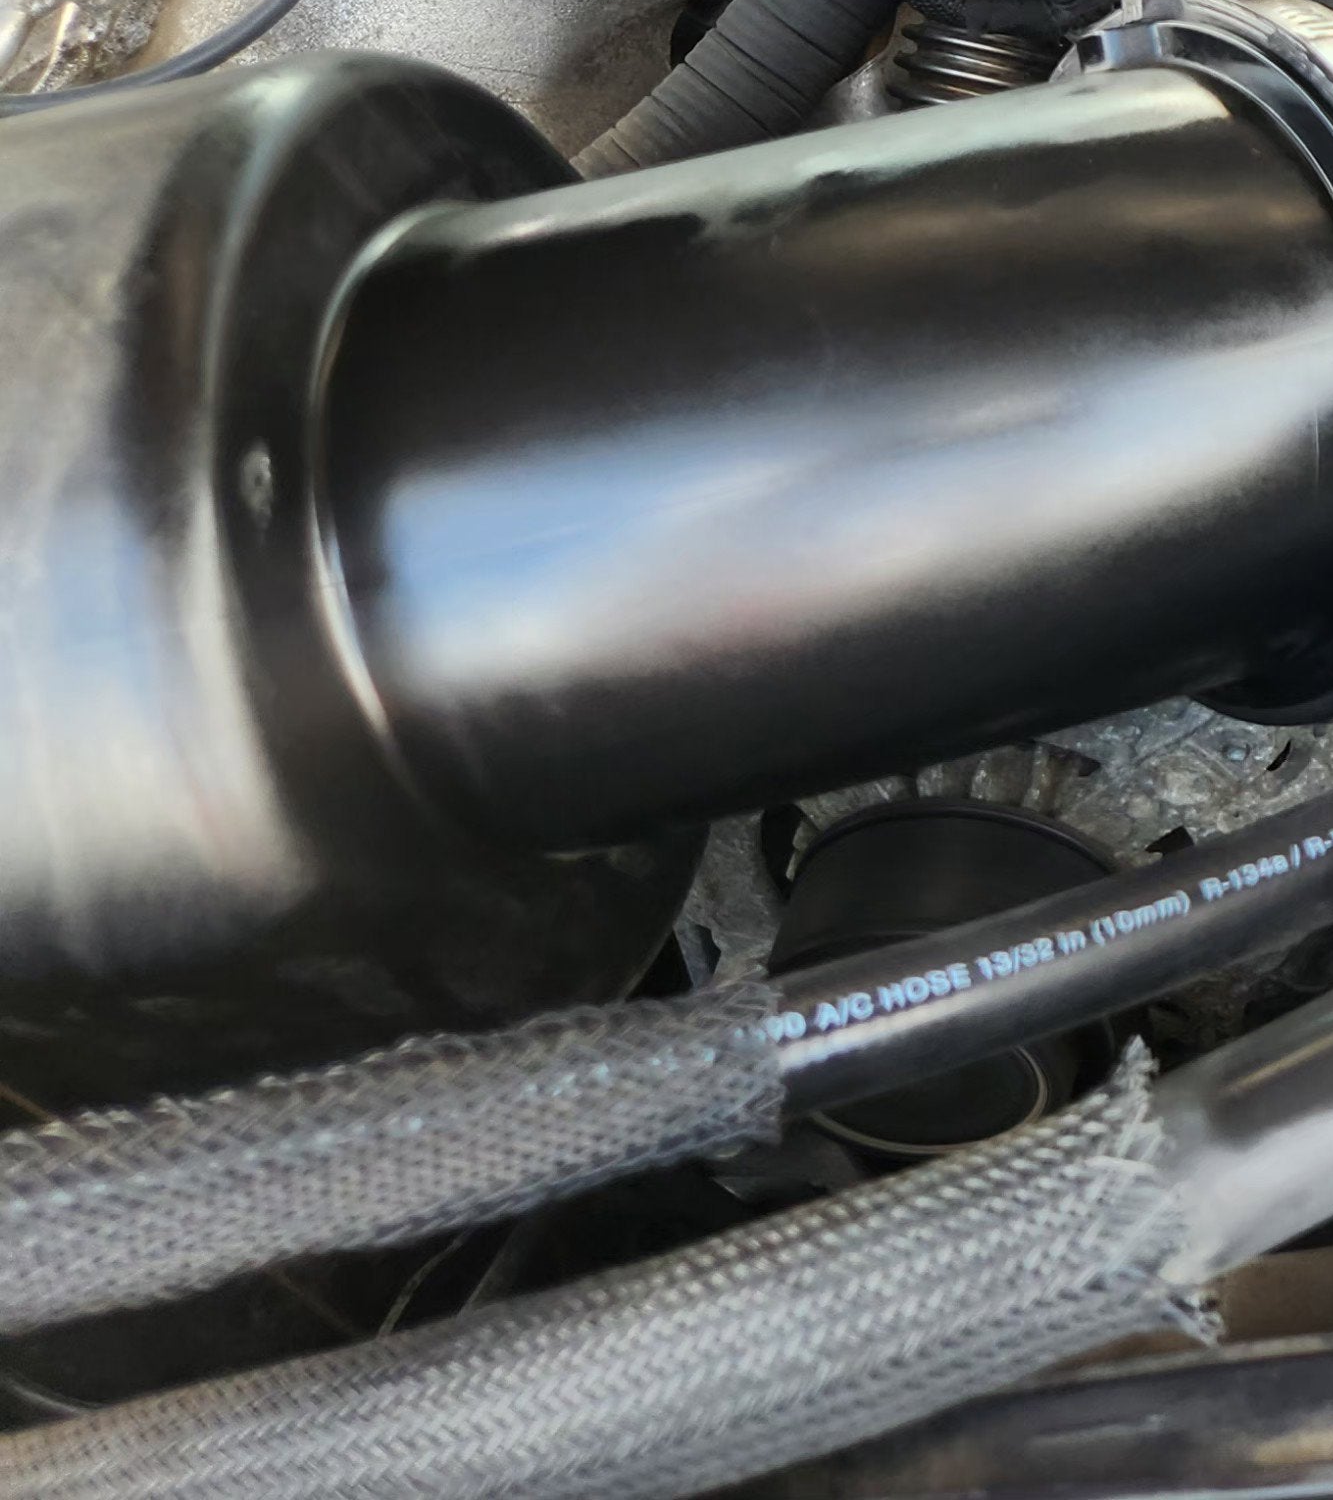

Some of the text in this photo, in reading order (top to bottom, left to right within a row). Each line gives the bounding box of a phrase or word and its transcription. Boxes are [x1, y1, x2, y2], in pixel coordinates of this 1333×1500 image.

[814, 991, 874, 1031] A/C
[877, 962, 971, 1013] HOSE
[975, 937, 1054, 980] 13/32
[1056, 930, 1086, 956] in
[1090, 889, 1191, 947] (10mm)
[1200, 854, 1289, 902] R-134a
